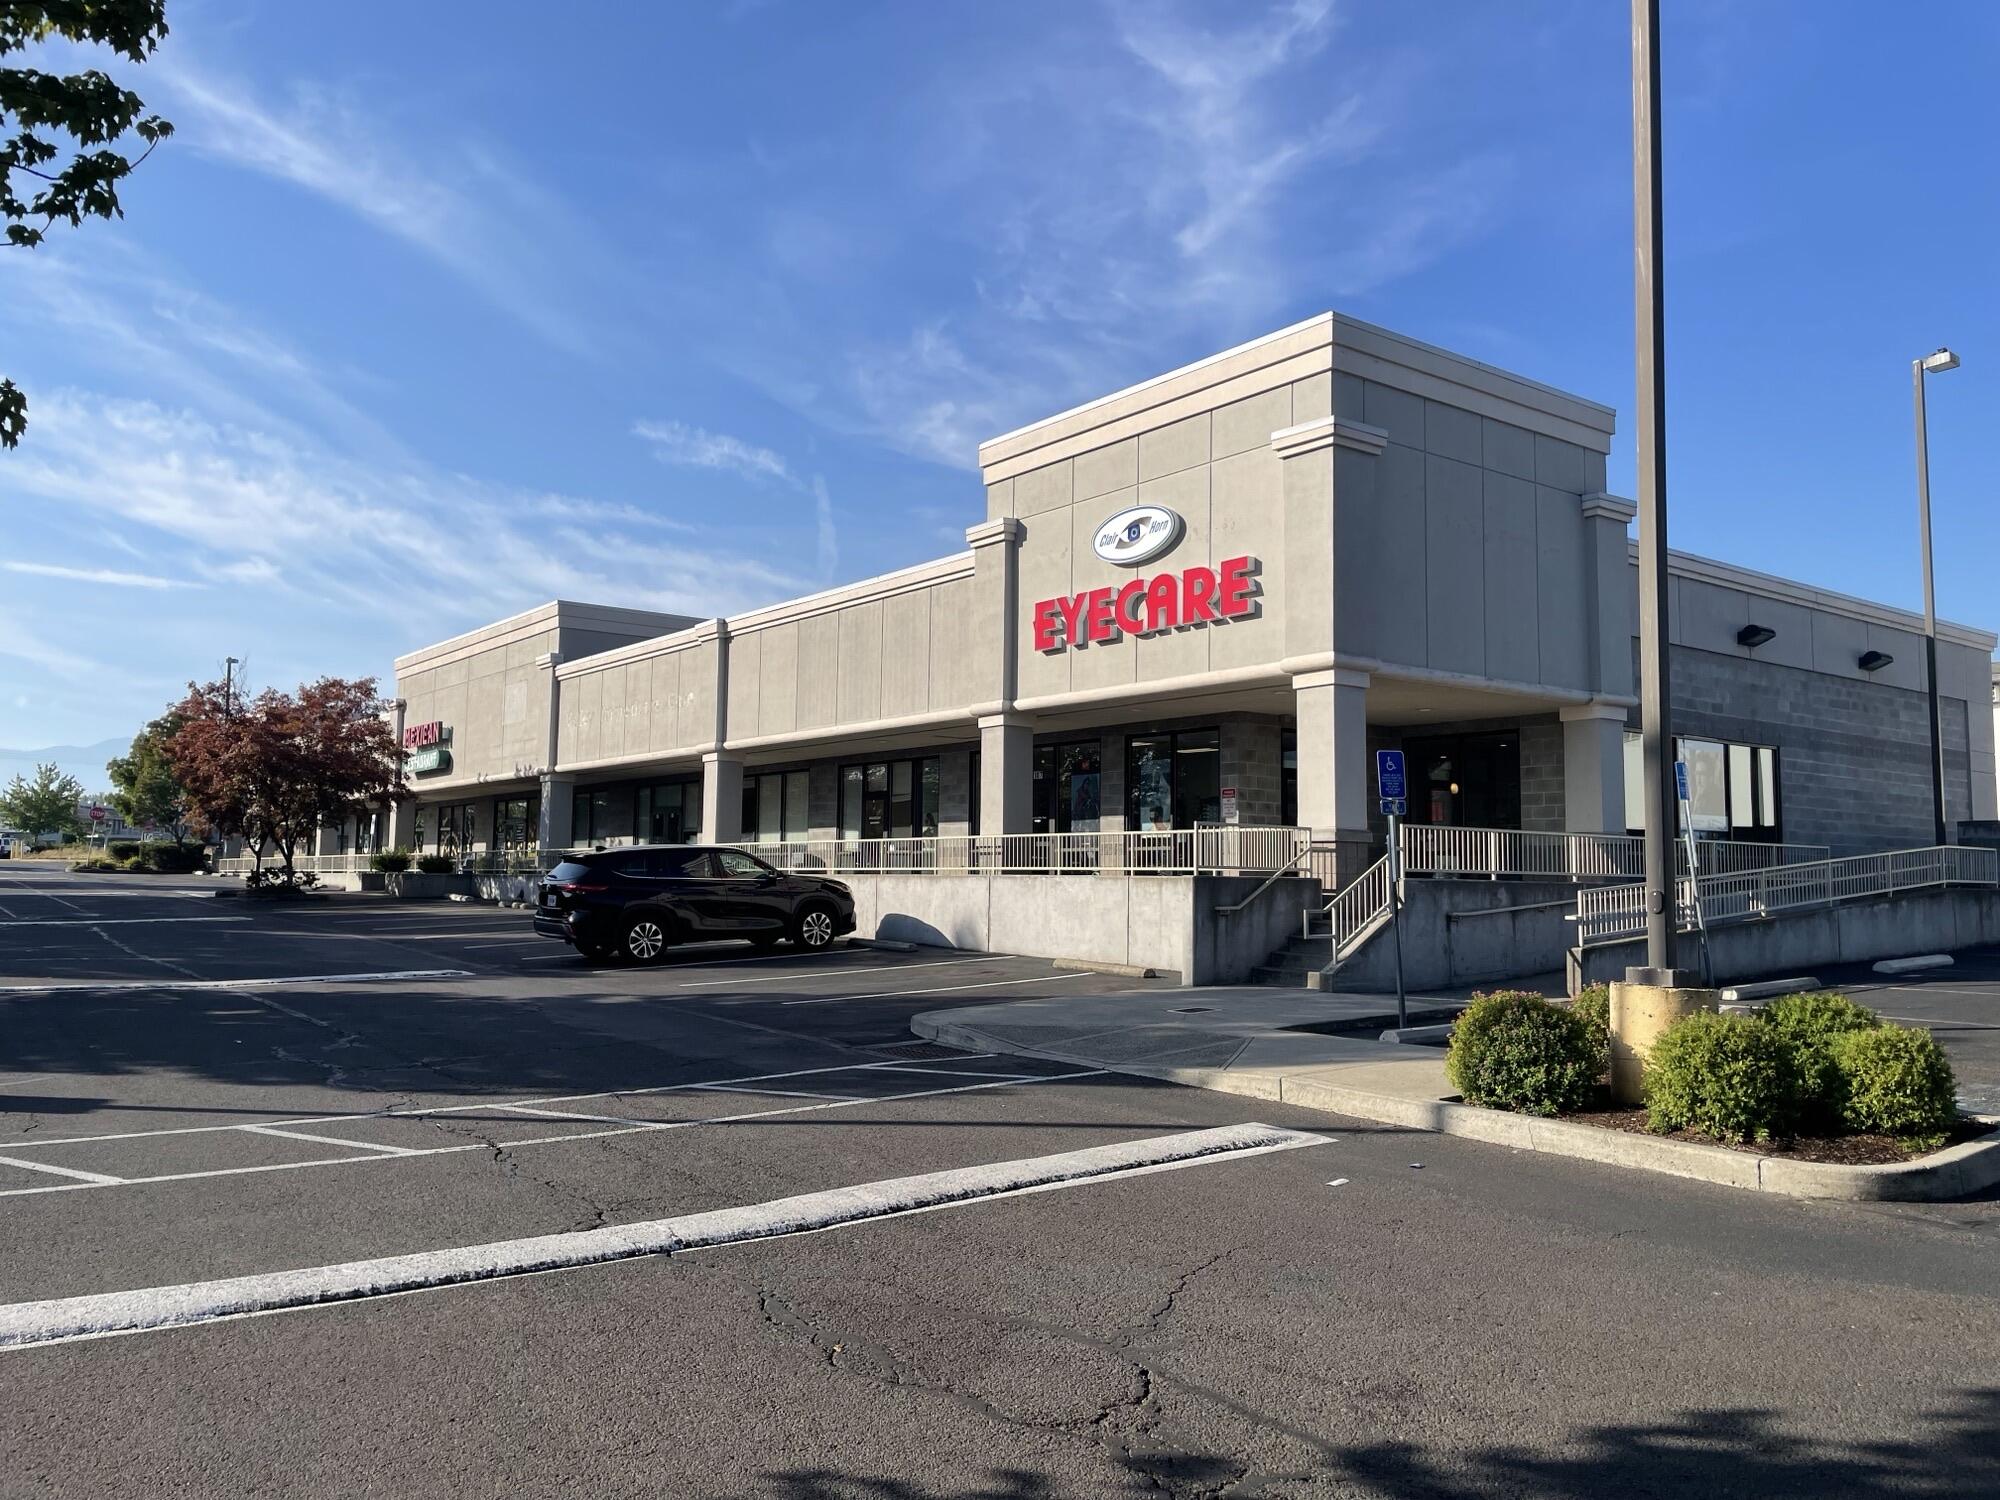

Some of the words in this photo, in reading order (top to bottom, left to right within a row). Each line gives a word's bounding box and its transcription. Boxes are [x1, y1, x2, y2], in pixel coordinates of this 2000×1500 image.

[1099, 532, 1119, 548] Clair
[1149, 520, 1169, 534] Horn
[1033, 556, 1251, 651] EYECARE
[403, 721, 439, 748] MEXICAN
